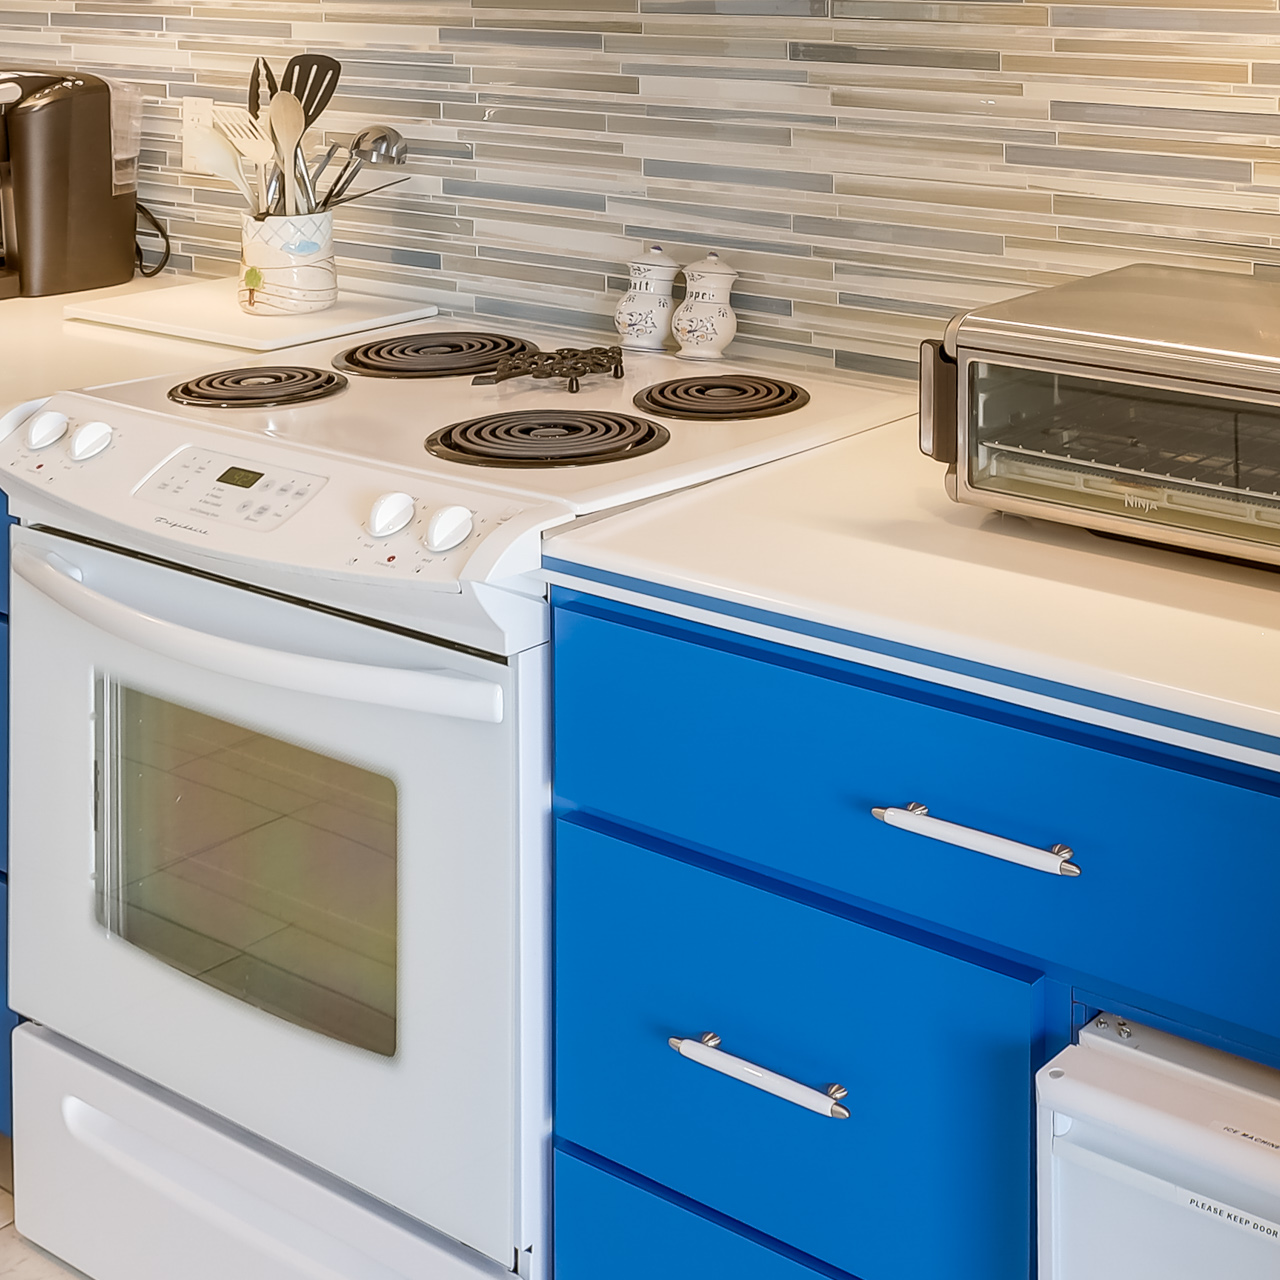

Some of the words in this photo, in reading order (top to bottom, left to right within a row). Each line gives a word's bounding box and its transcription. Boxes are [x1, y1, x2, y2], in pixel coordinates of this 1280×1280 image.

[1223, 1126, 1240, 1134] ICE
[1190, 1198, 1224, 1218] PLEASE
[1226, 1212, 1250, 1226] KEEP
[1252, 1222, 1279, 1238] DOOR
